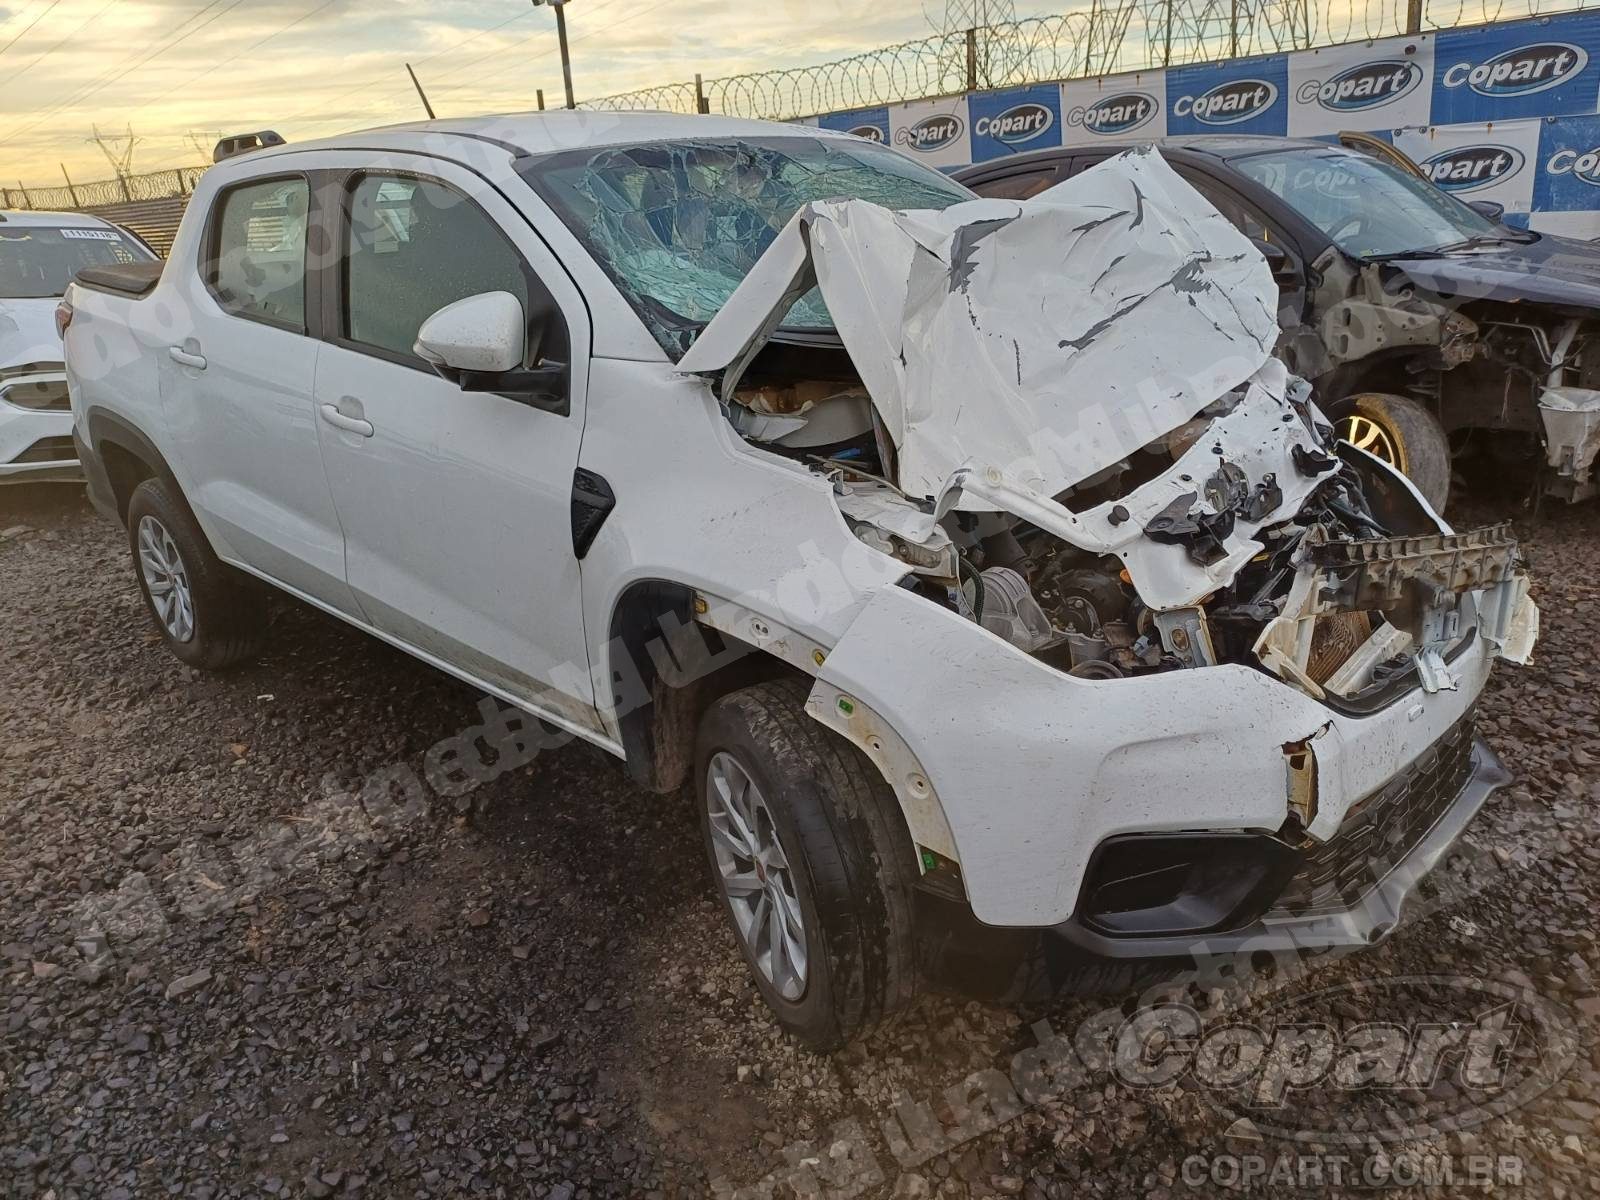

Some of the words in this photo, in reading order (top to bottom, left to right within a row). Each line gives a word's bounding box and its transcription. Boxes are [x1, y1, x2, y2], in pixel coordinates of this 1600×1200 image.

[1296, 64, 1411, 104] Copart
[1443, 51, 1574, 90] Copart
[1067, 98, 1147, 128] Copart
[1173, 84, 1266, 118] Copart
[895, 120, 955, 149] Copart
[975, 108, 1044, 142] Copart
[1418, 153, 1507, 183] opart
